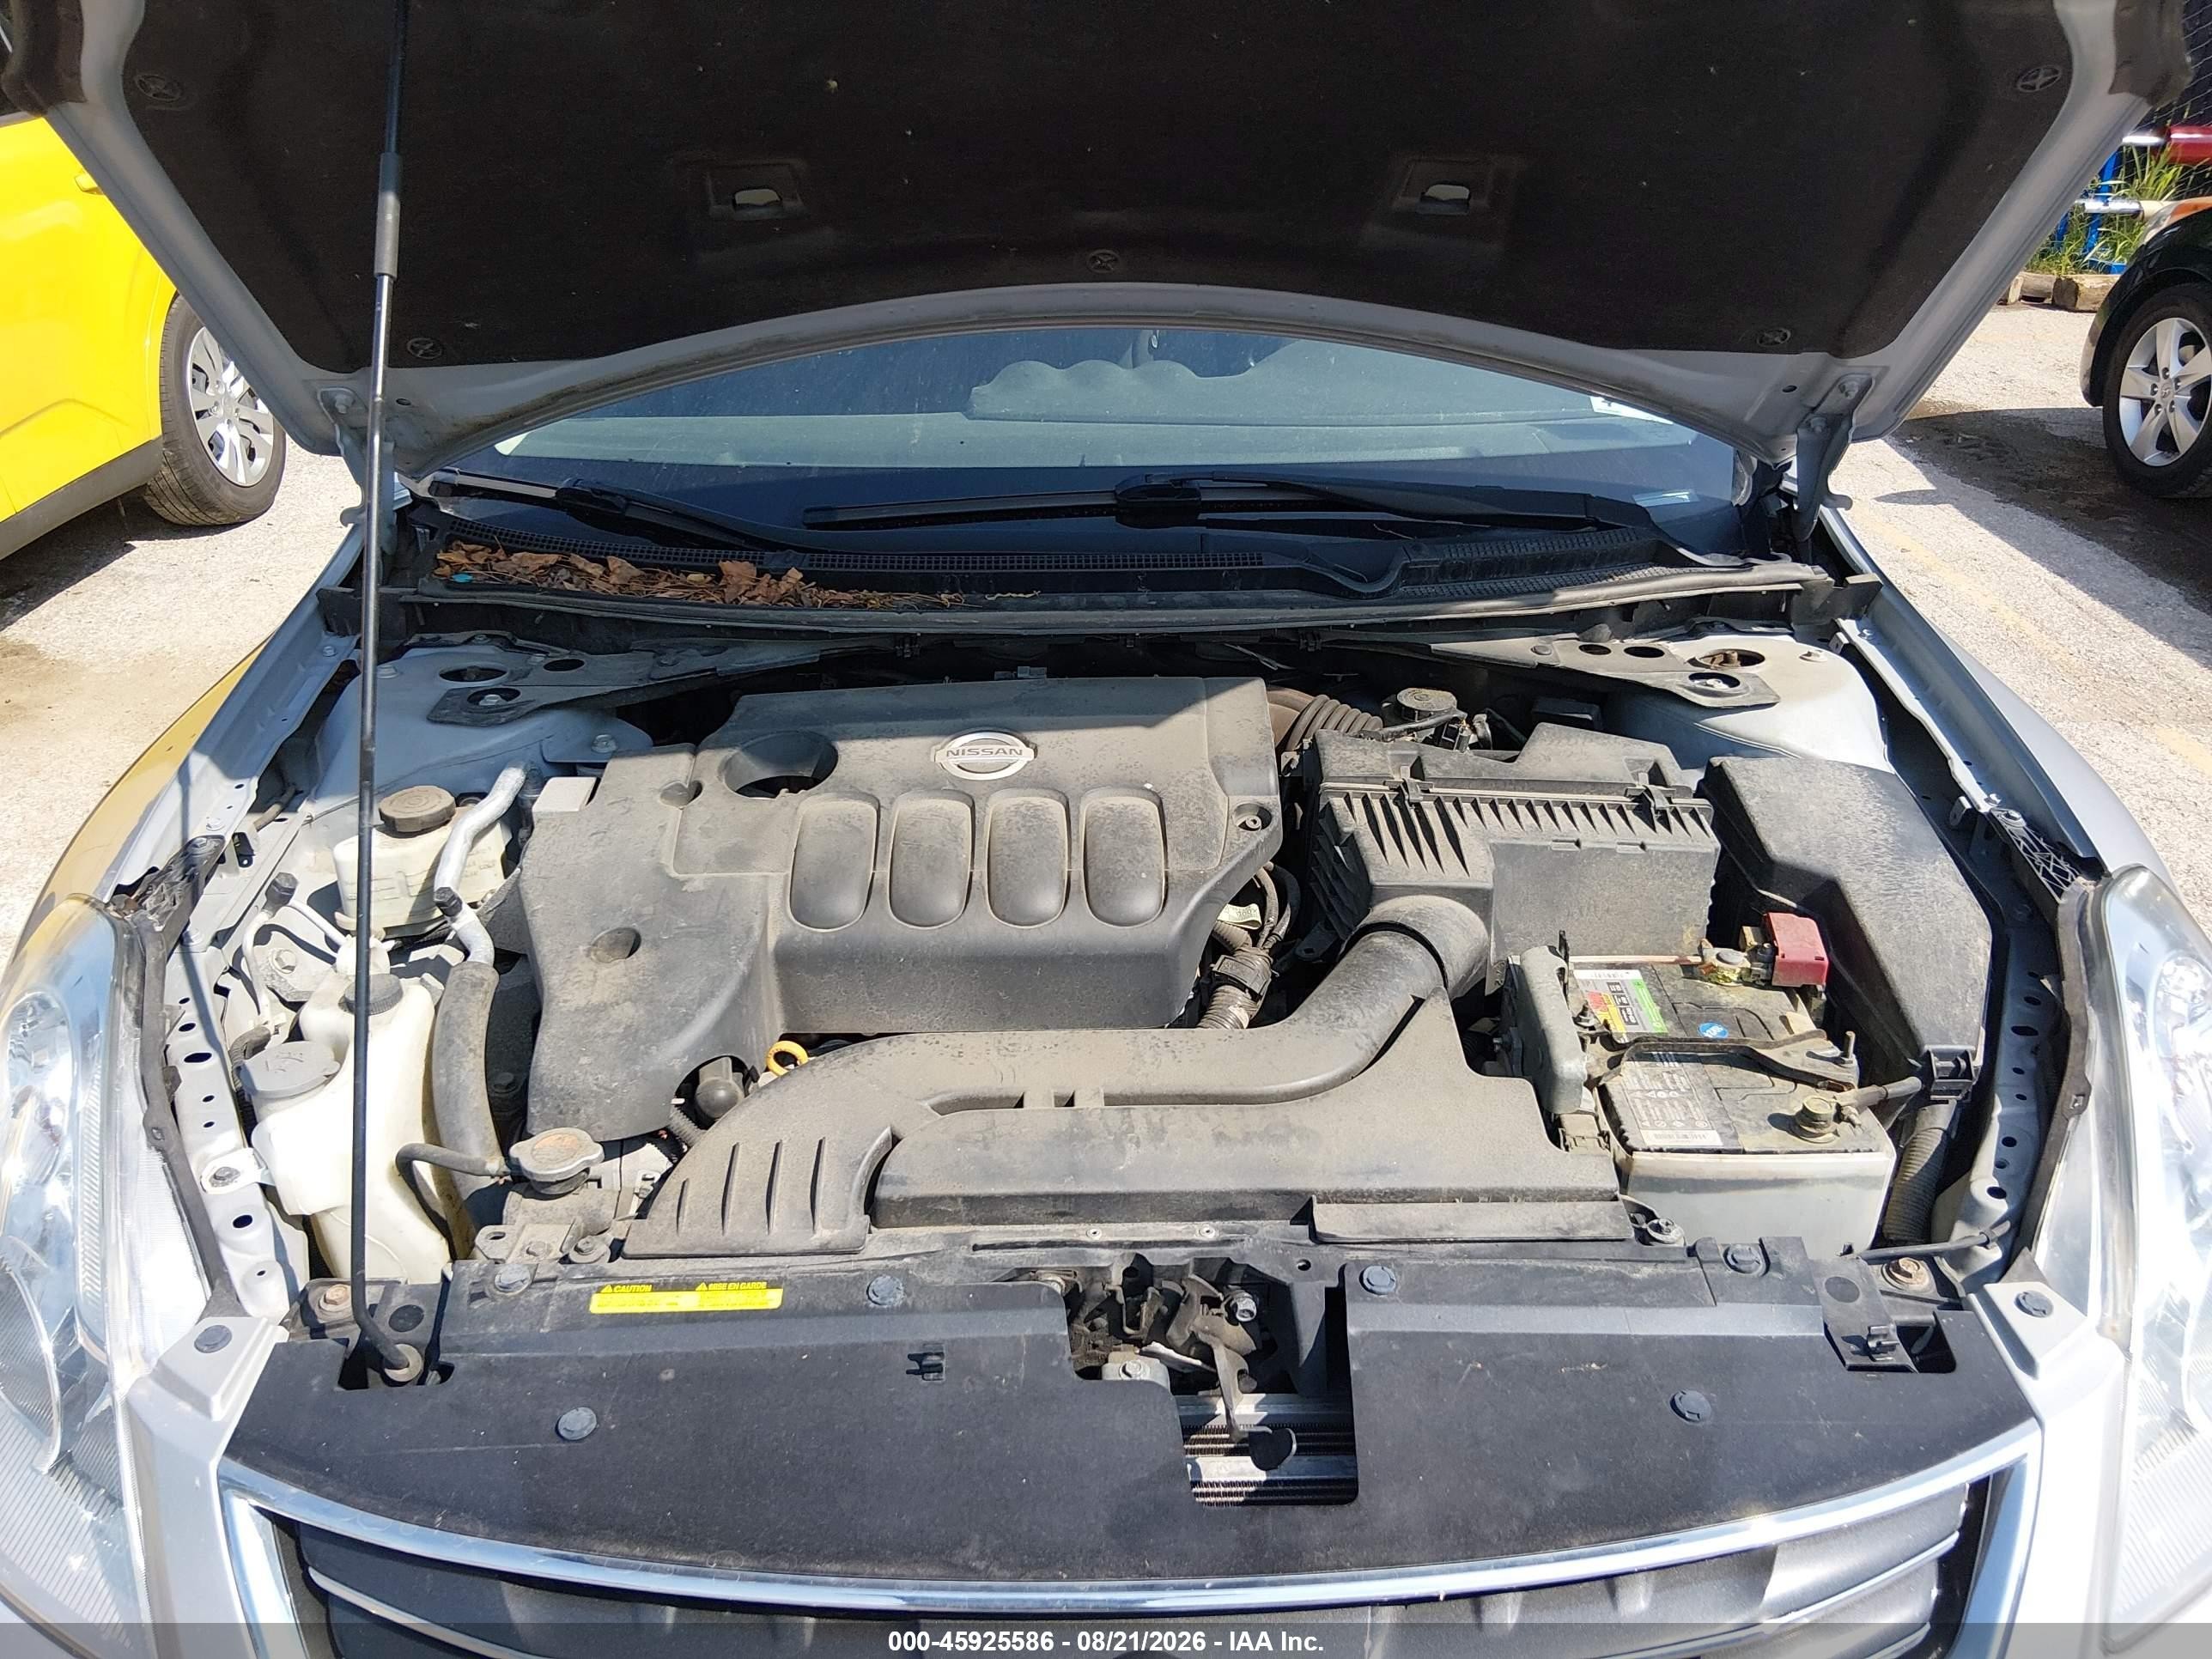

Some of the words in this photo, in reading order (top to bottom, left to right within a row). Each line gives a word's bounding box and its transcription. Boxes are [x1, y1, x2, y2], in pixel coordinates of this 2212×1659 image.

[946, 748, 1023, 757] NISSAN
[613, 1284, 653, 1293] CAUTION
[727, 1282, 739, 1291] EN
[739, 1281, 768, 1290] GARDE
